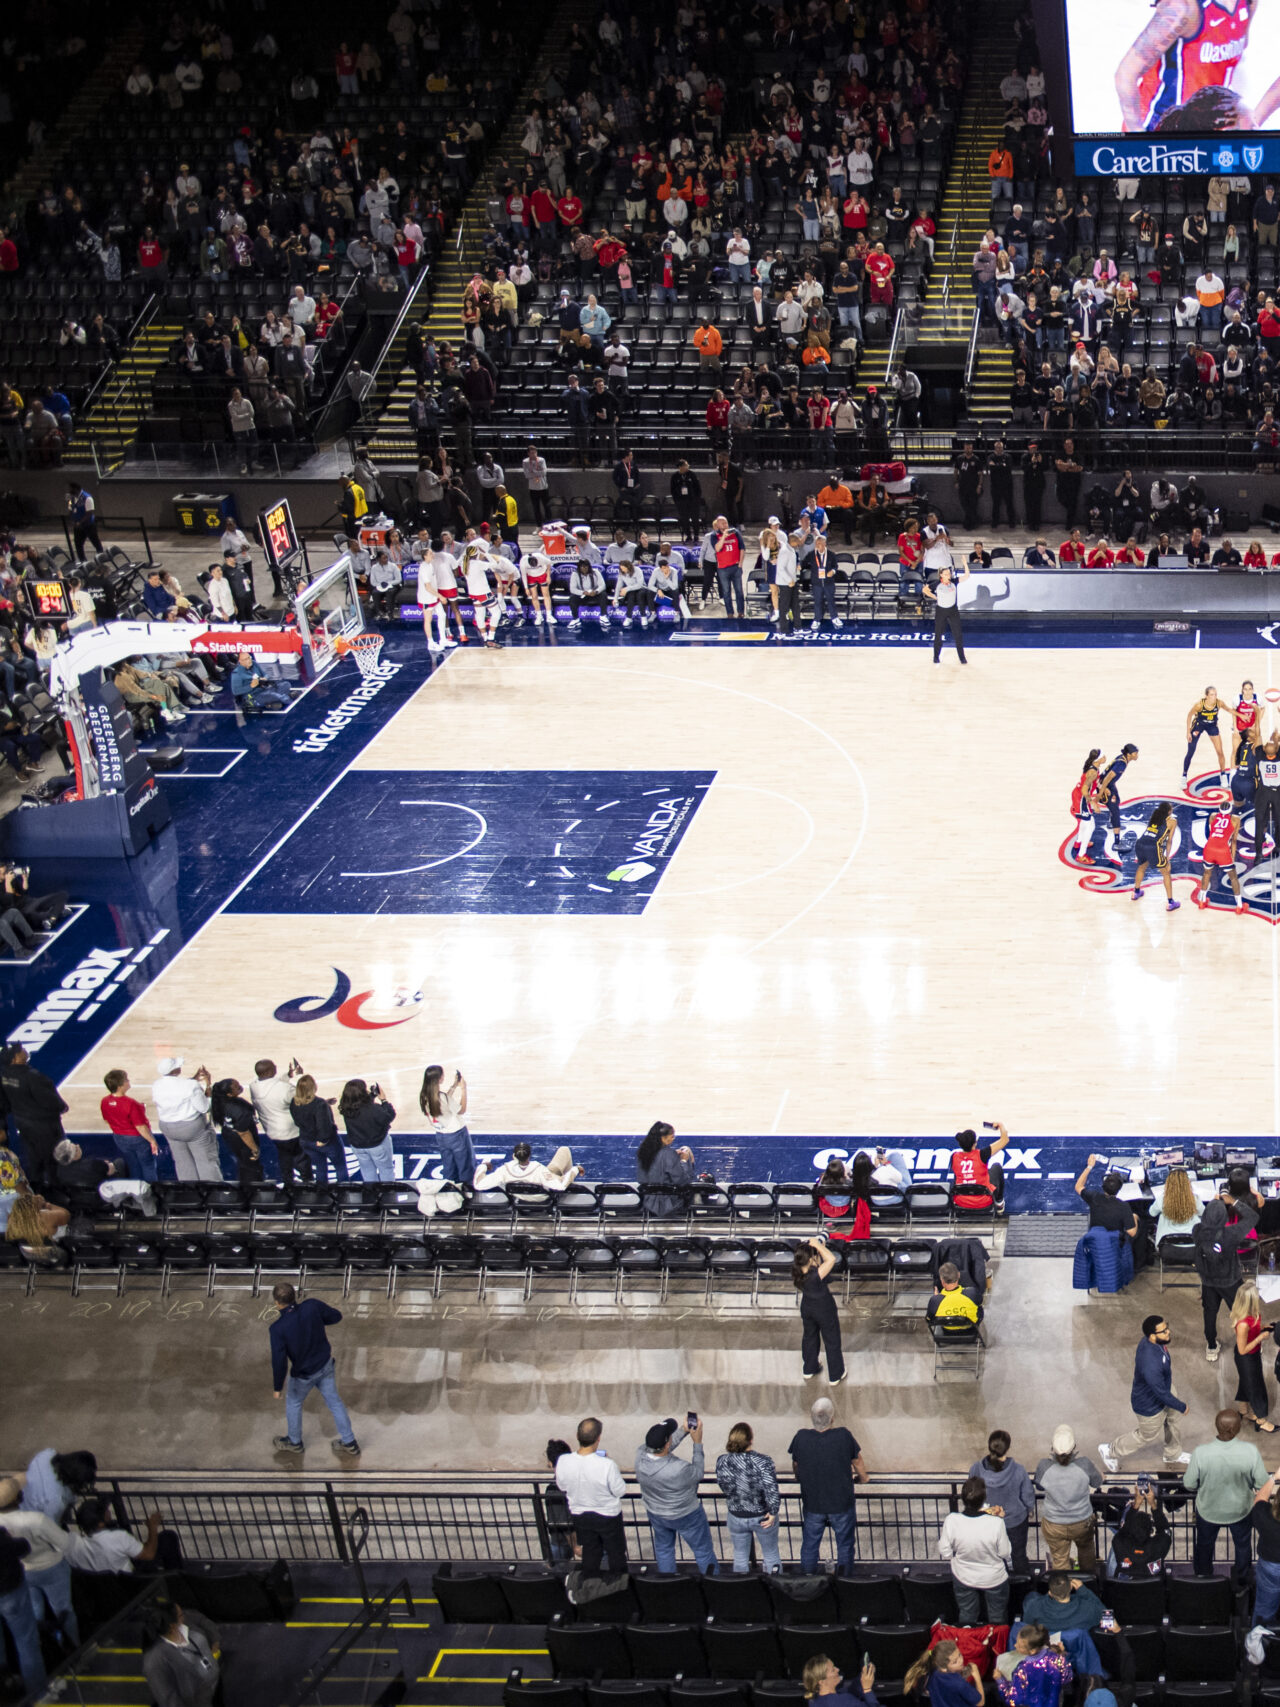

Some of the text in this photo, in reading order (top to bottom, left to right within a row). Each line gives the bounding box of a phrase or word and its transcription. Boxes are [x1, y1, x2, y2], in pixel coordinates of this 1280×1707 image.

[1092, 145, 1208, 175] CareFirst
[271, 525, 291, 558] 24
[36, 583, 62, 597] 10:00
[40, 597, 61, 613] 24
[580, 609, 600, 617] xfinity
[292, 659, 404, 753] ticketmaster
[88, 711, 112, 782] BEDERMAN
[98, 705, 122, 782] GREENBERG
[1266, 764, 1277, 773] 59
[626, 797, 684, 861] VANDA
[1213, 818, 1229, 829] 20
[960, 1160, 974, 1173] 22
